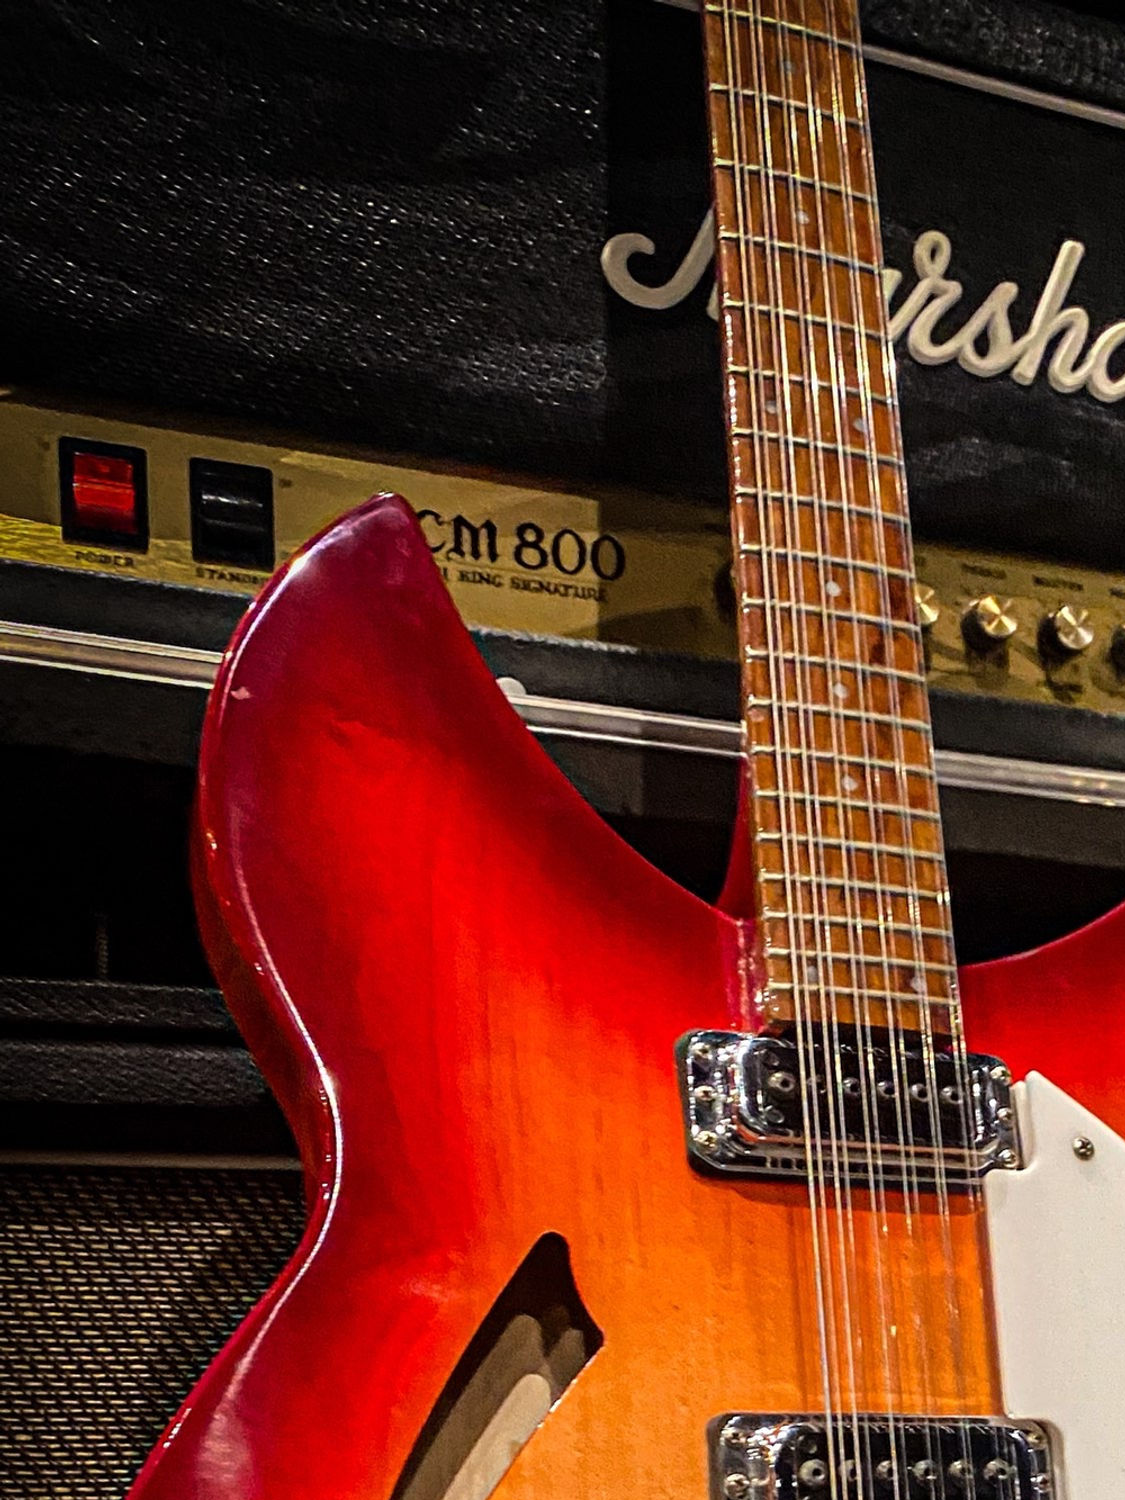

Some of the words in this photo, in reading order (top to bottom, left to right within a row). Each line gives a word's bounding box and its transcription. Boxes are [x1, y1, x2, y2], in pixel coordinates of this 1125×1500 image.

[75, 550, 135, 567] POWER
[514, 522, 627, 582] 800
[458, 569, 504, 588] KING
[510, 576, 608, 603] SIGNATURE
